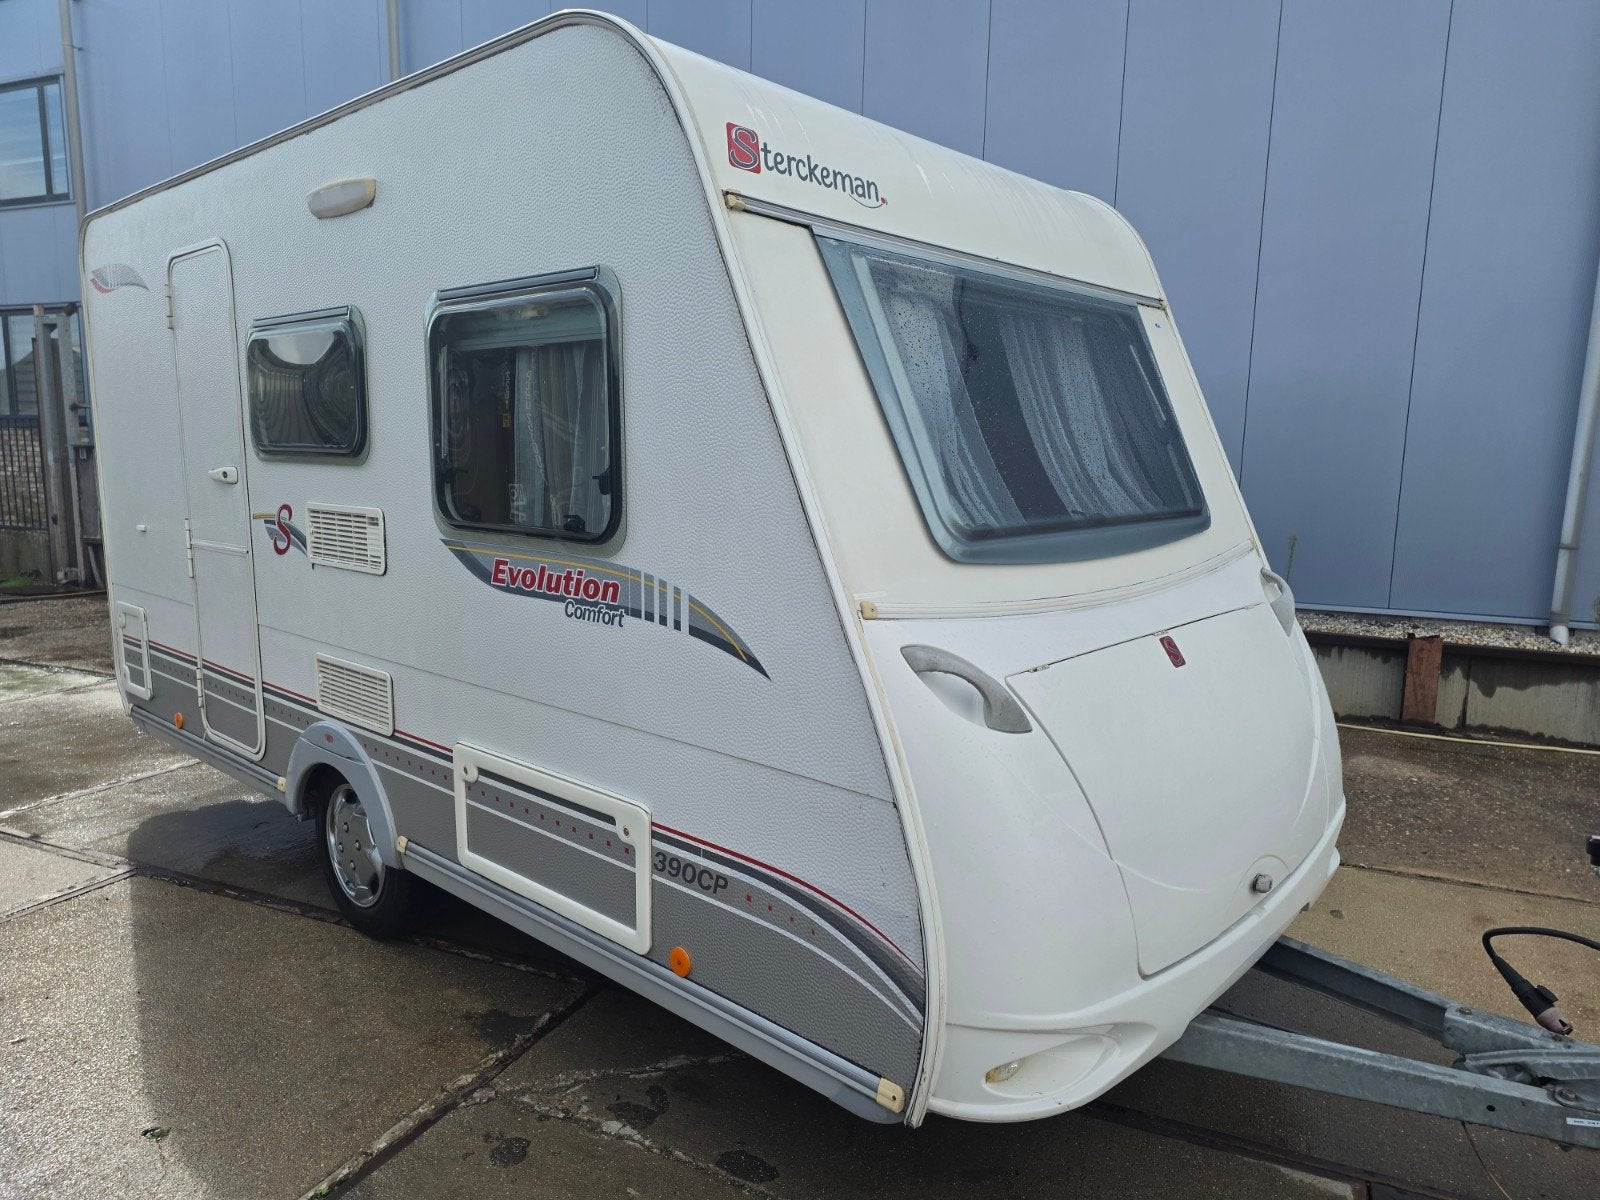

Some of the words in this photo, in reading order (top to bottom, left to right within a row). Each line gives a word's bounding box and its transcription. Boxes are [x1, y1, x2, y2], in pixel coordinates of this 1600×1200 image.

[730, 127, 884, 207] Sterckeman
[491, 558, 620, 604] Evolution
[564, 600, 625, 628] Comfort
[653, 851, 729, 894] 390CP
